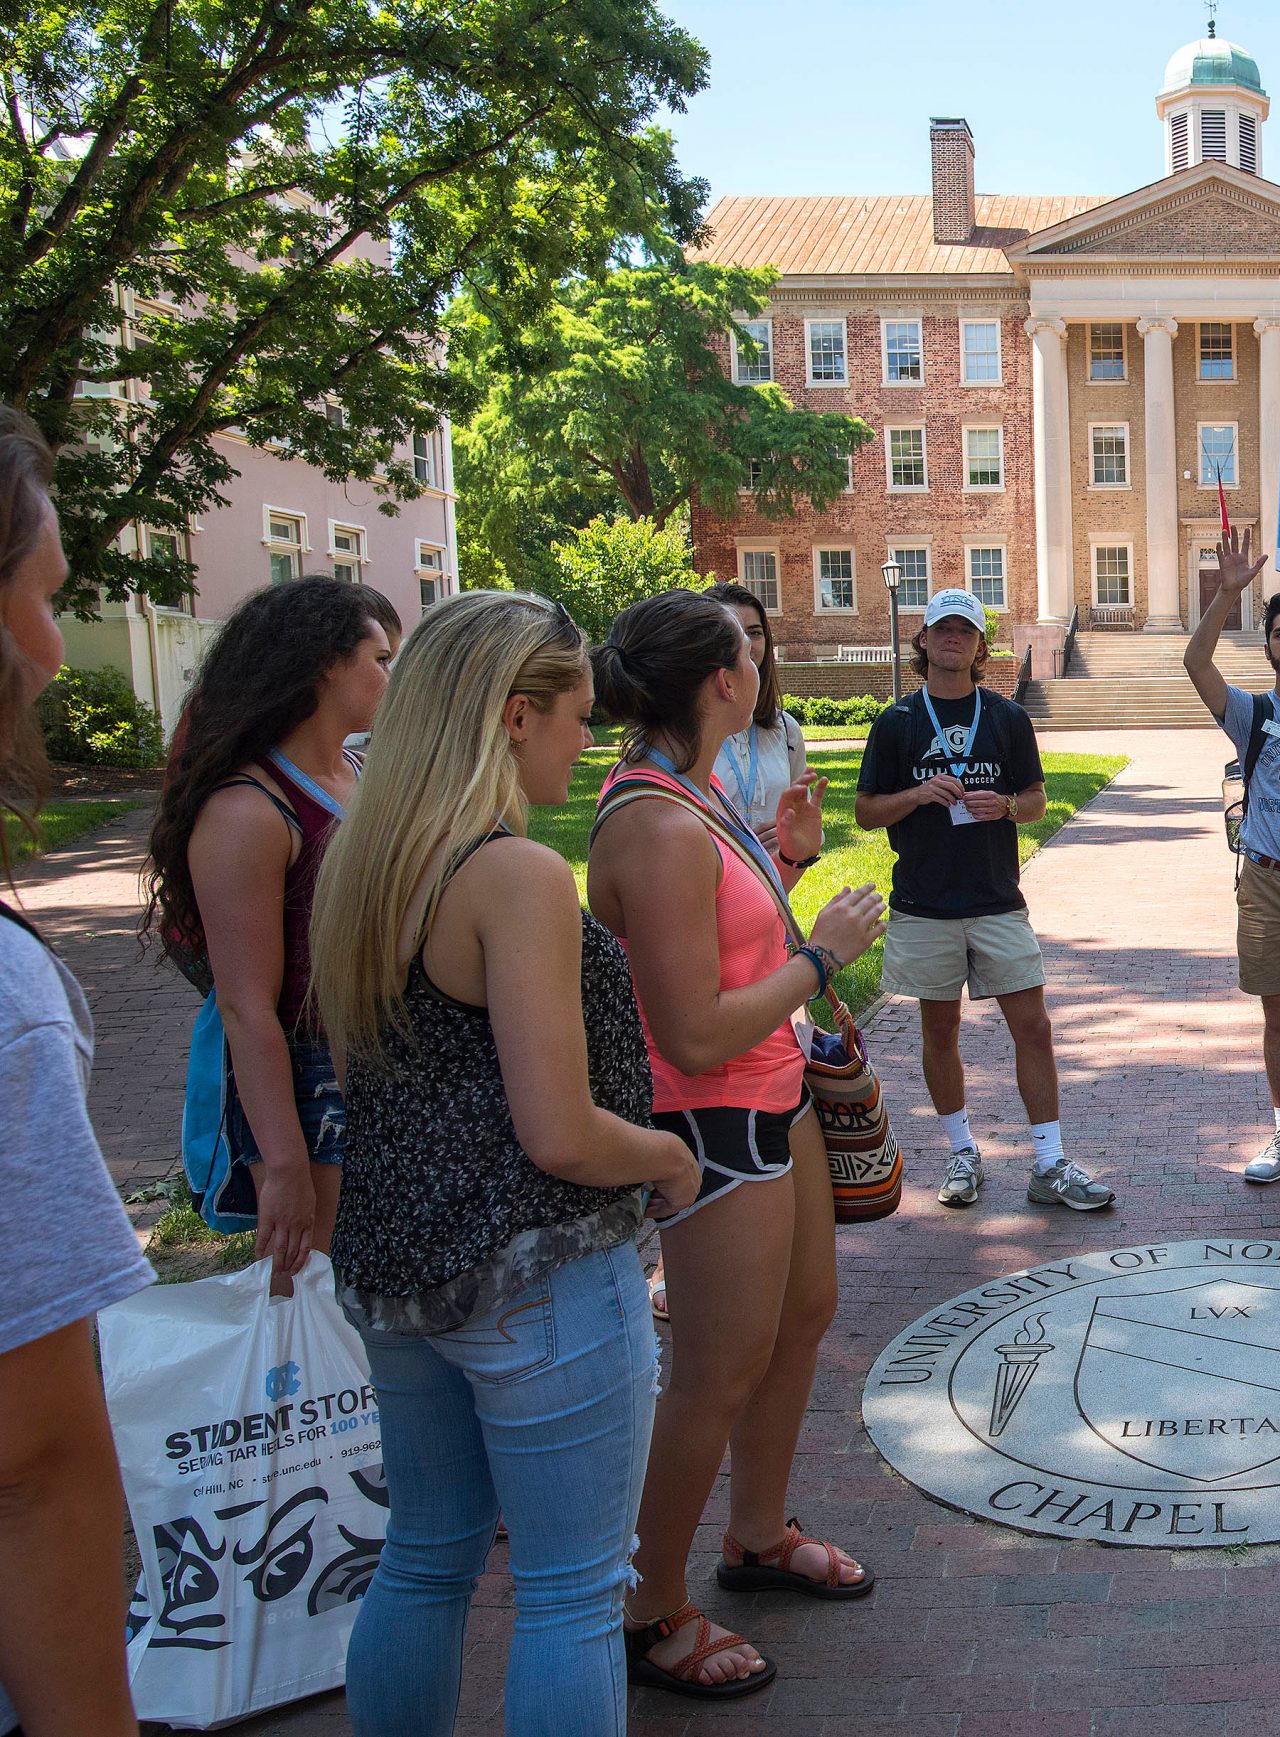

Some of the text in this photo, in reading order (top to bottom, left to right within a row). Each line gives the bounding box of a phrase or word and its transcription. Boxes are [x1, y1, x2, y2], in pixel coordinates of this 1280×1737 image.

[949, 730, 964, 746] G
[964, 777, 995, 785] SOCCER
[879, 1262, 1080, 1387] UNIVERSITY
[1109, 1247, 1168, 1269] OF
[1190, 1305, 1252, 1320] LVX
[299, 1384, 379, 1426] STOR
[227, 1444, 257, 1463] TAR
[297, 1425, 327, 1444] FOR
[329, 1415, 359, 1436] 100
[361, 1410, 380, 1427] YE
[228, 1478, 245, 1490] NC
[261, 1456, 322, 1484] stre.unc.edu
[340, 1439, 382, 1459] 919-962
[988, 1480, 1250, 1535] CHAPEL
